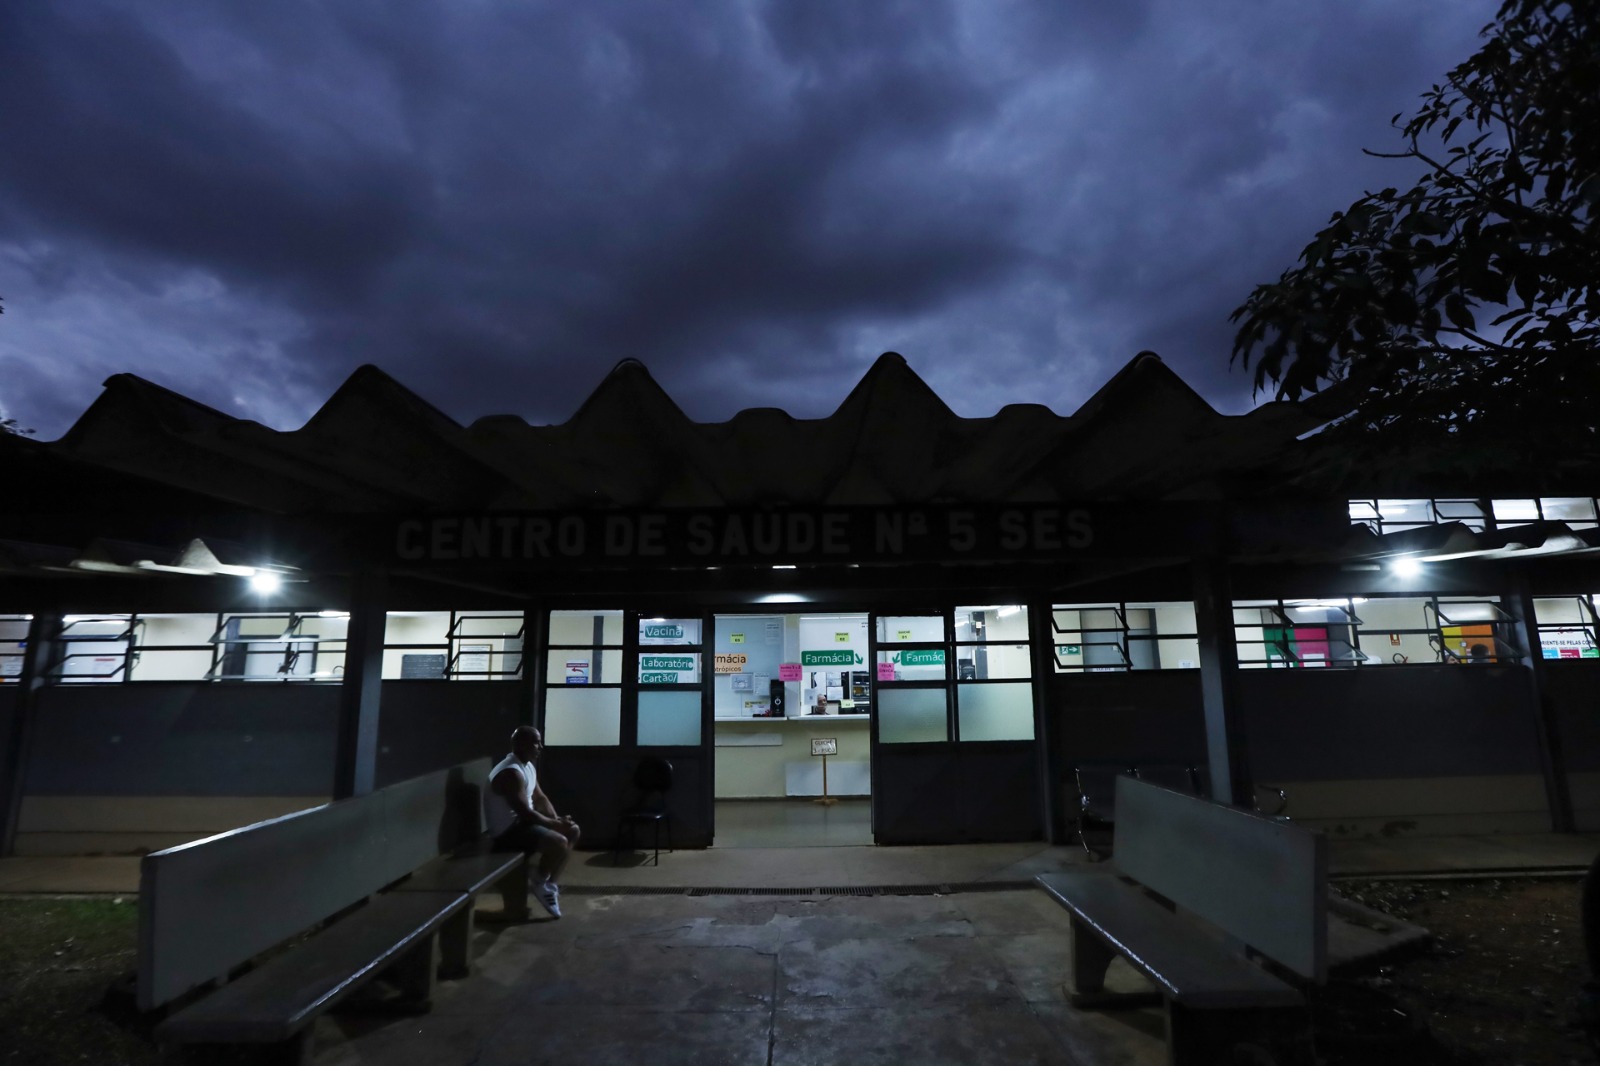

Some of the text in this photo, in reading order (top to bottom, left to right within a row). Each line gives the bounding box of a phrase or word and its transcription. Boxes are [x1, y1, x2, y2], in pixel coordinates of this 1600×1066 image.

[395, 516, 586, 560] CENTRO
[604, 514, 668, 557] DE
[686, 503, 850, 558] SAÚDE
[947, 510, 977, 552] 5
[998, 508, 1095, 551] SES
[646, 627, 682, 636] Vacina
[805, 652, 852, 663] Farmácia
